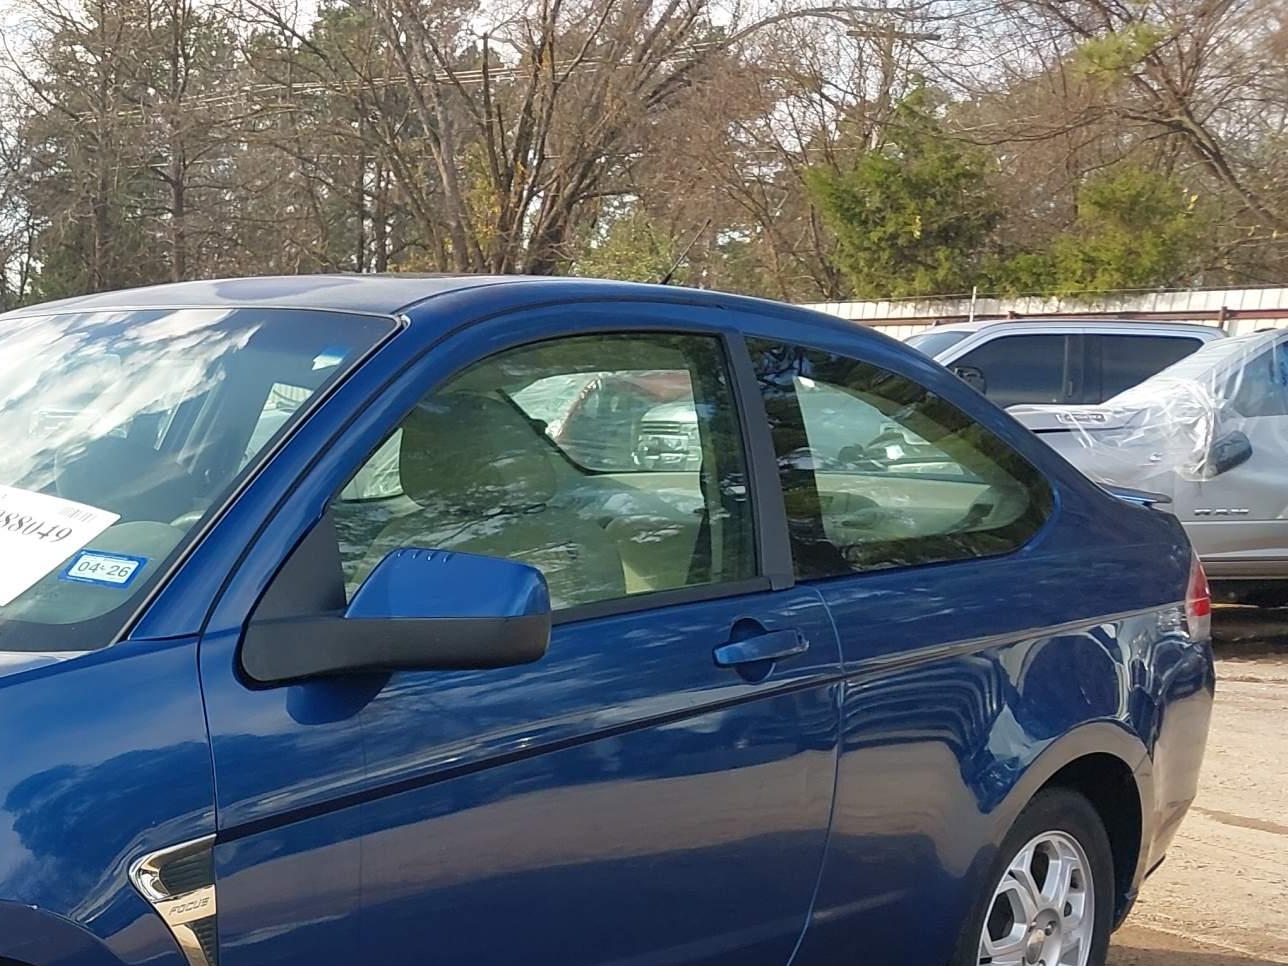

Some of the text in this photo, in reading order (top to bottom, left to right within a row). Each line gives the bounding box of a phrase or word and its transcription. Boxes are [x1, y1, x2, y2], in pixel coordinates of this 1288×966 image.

[78, 561, 131, 578] 04 26
[169, 896, 210, 915] FOCUS
